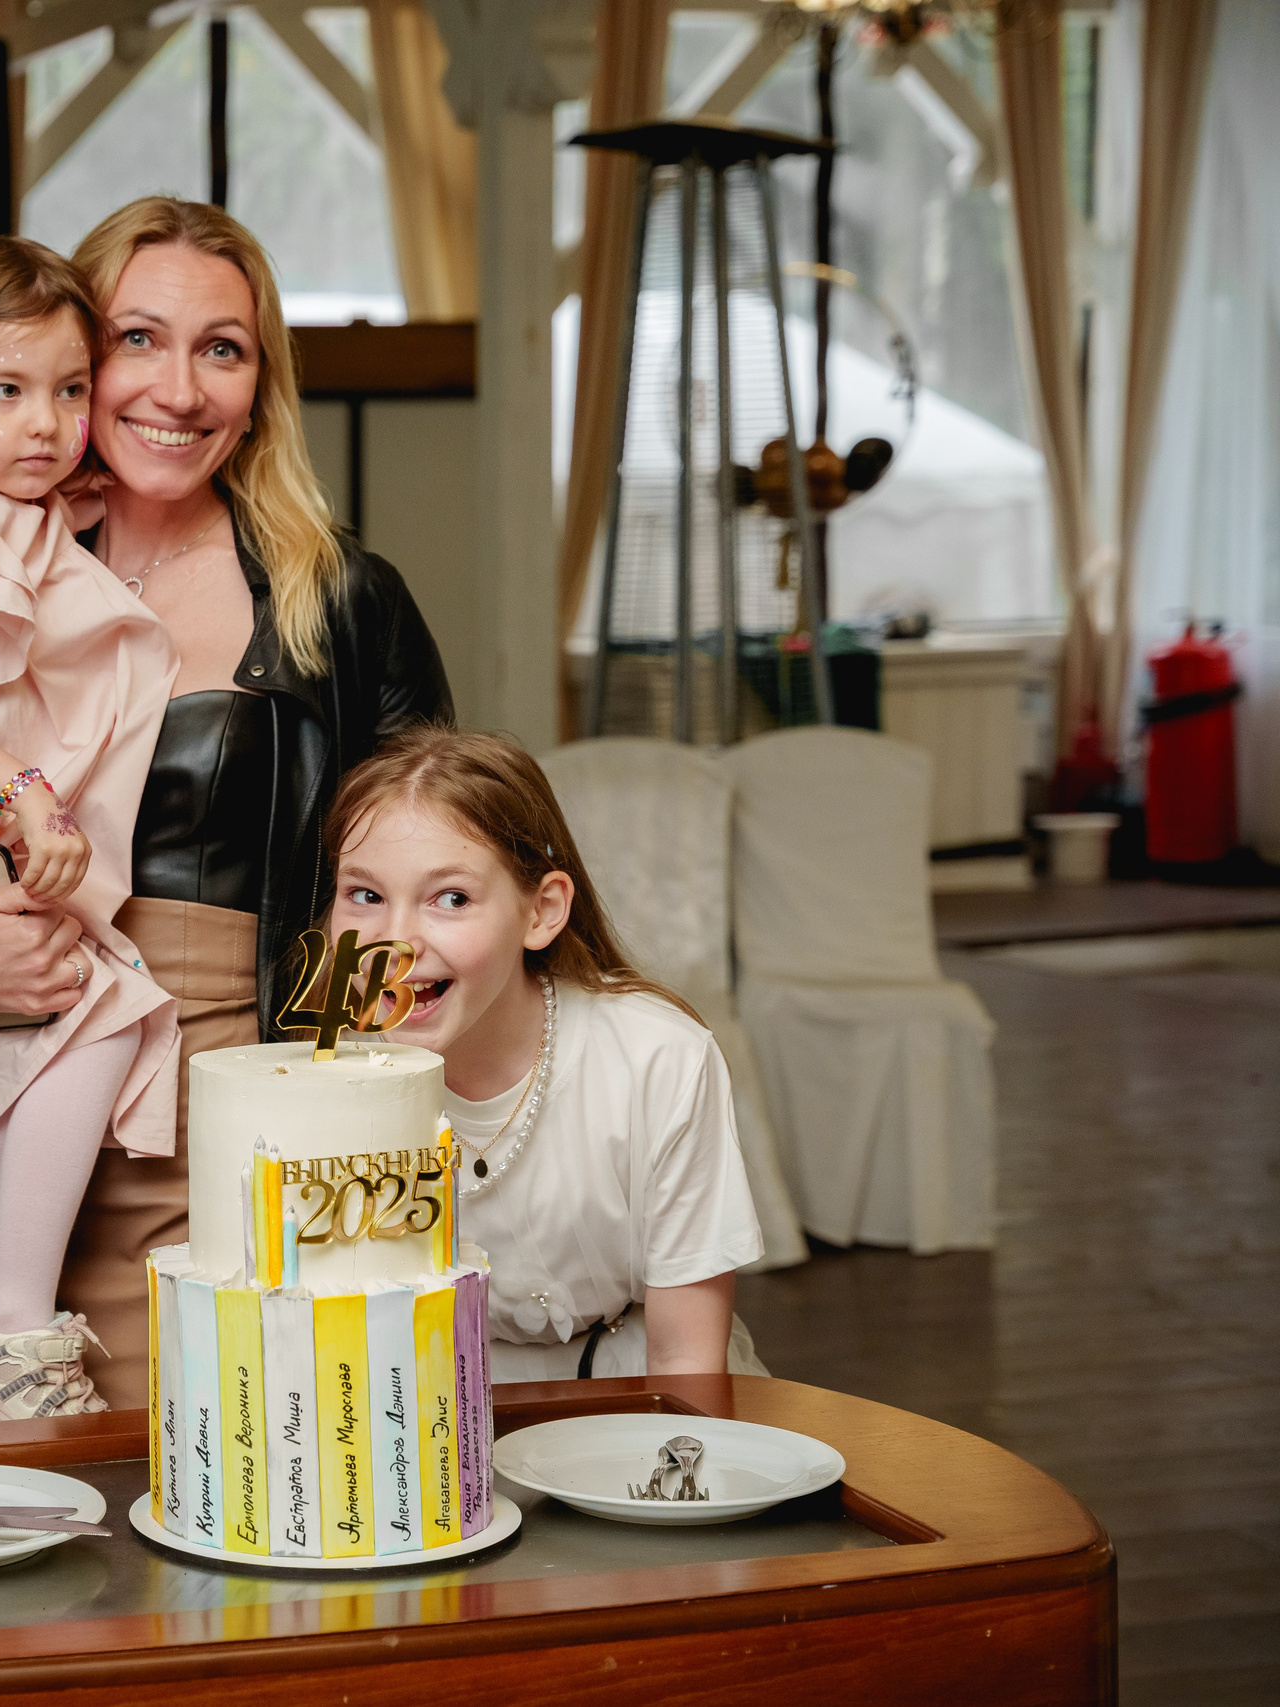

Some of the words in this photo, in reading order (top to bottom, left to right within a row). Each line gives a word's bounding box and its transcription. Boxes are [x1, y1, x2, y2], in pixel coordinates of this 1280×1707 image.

[281, 1144, 463, 1185] ВЫПУСКНИКИ
[296, 1169, 443, 1246] 2025
[164, 1399, 176, 1446] Алан
[235, 1366, 255, 1449] Вероника
[283, 1391, 304, 1445] Миша
[337, 1363, 359, 1445] Мирослава
[385, 1367, 406, 1430] Даниил
[430, 1395, 450, 1438] Элис
[459, 1354, 470, 1471] Владимировна
[195, 1407, 210, 1468] Давид
[167, 1455, 181, 1518] Кутиев
[196, 1473, 215, 1537] Куприй
[237, 1455, 259, 1545] Ермолаева
[286, 1456, 309, 1547] Евстратов
[337, 1453, 364, 1544] Артемьева
[389, 1437, 411, 1542] Александров
[435, 1446, 451, 1532] Агабабаева
[464, 1482, 472, 1524] Юлия
